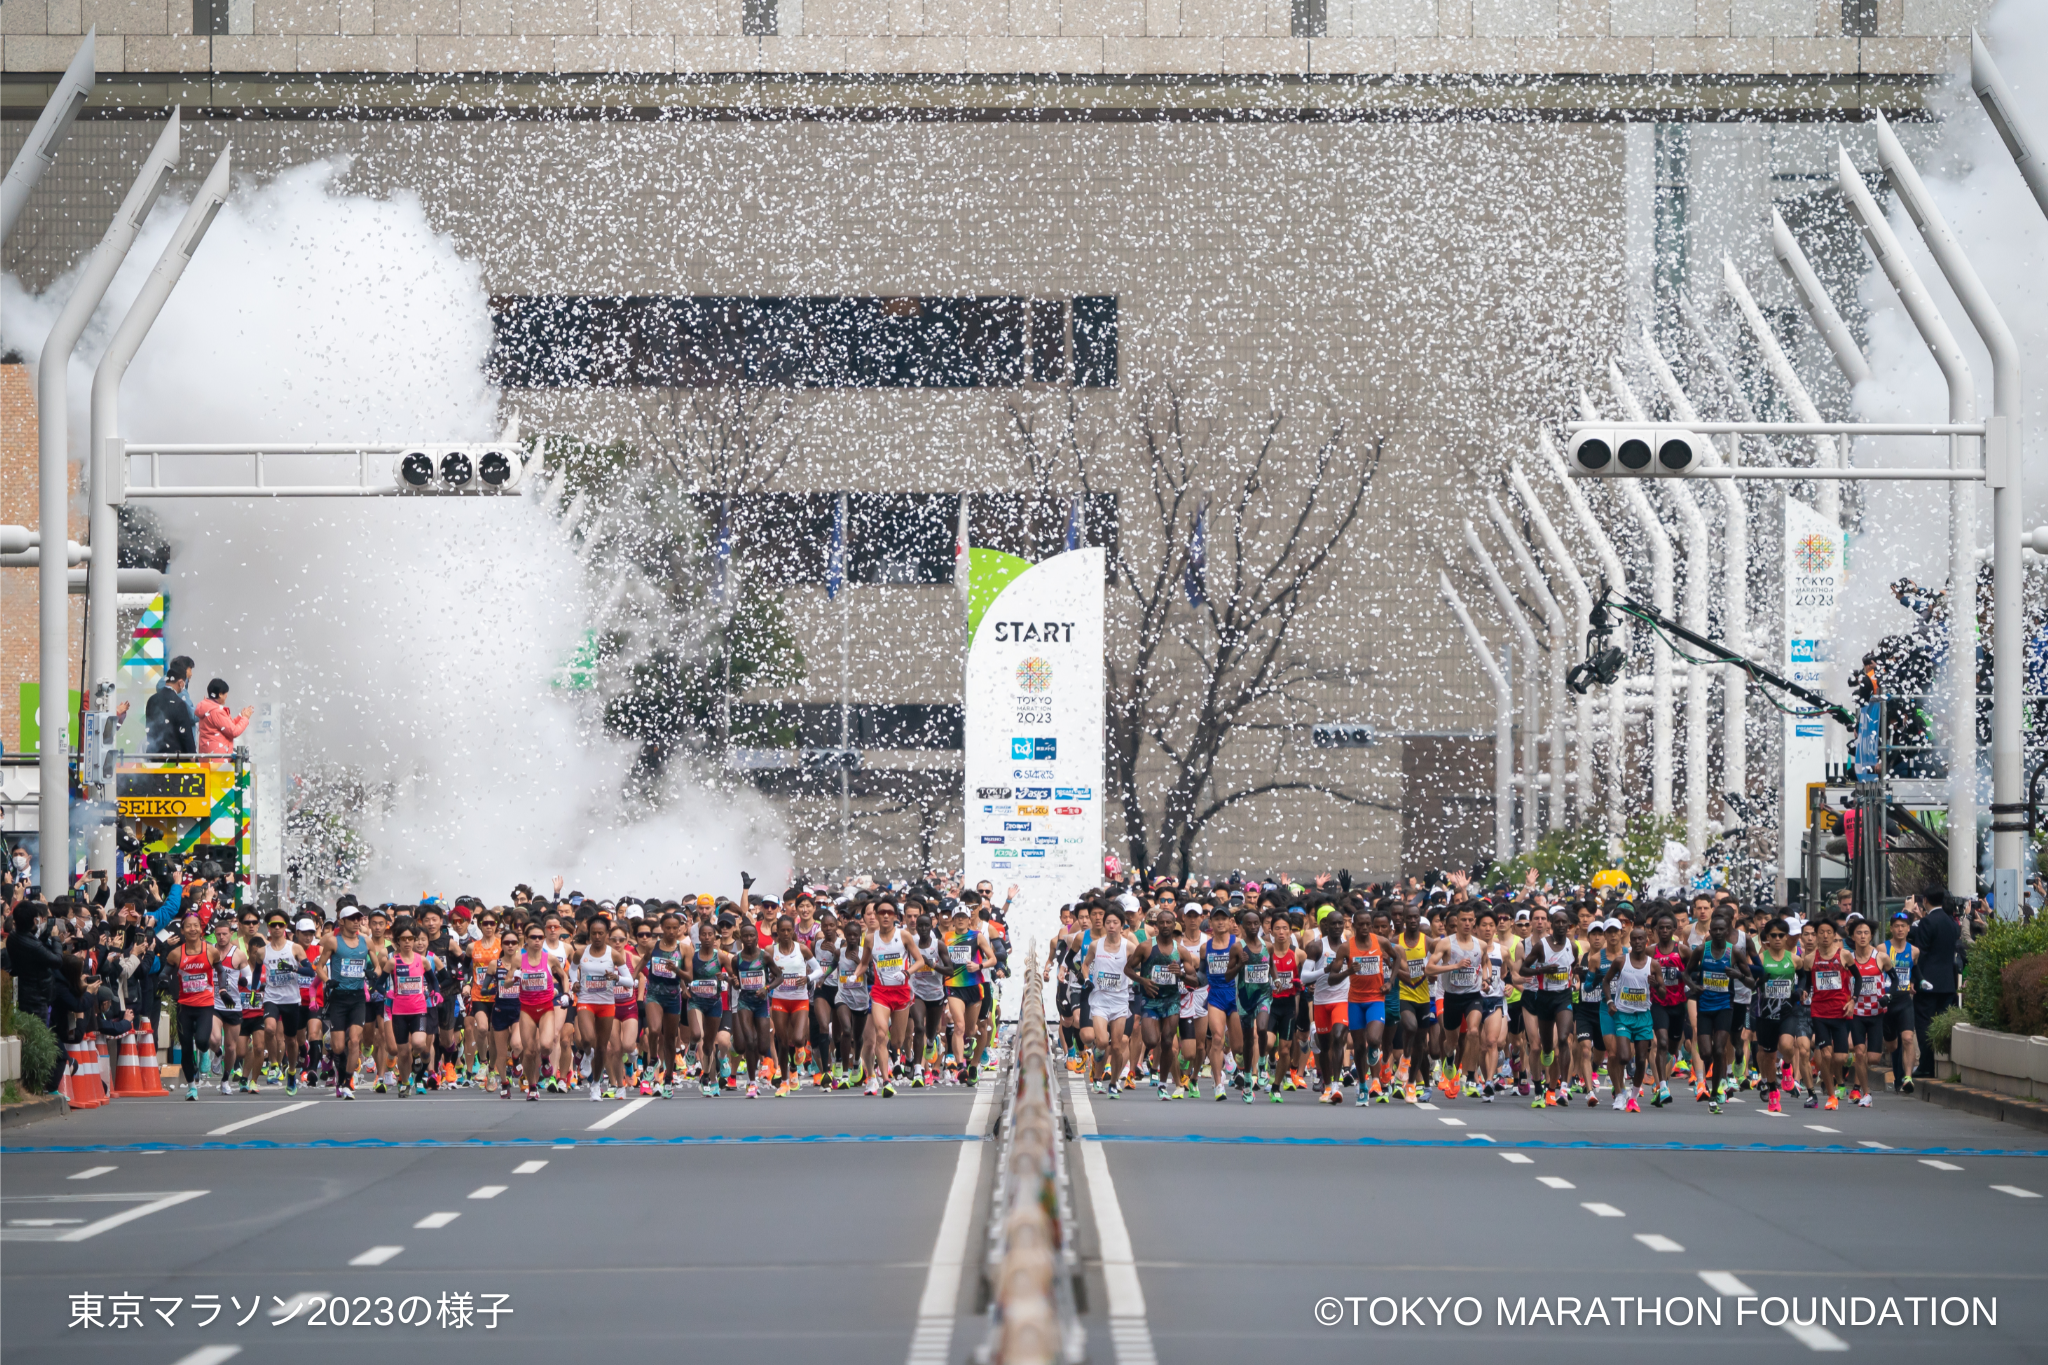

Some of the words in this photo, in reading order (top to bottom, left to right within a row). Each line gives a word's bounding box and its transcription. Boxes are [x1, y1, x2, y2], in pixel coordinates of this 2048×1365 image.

[1795, 594, 1834, 606] 2023
[995, 621, 1075, 643] START
[1016, 696, 1052, 705] TOKYO
[1016, 712, 1052, 724] 2023
[118, 800, 187, 816] SEIKO
